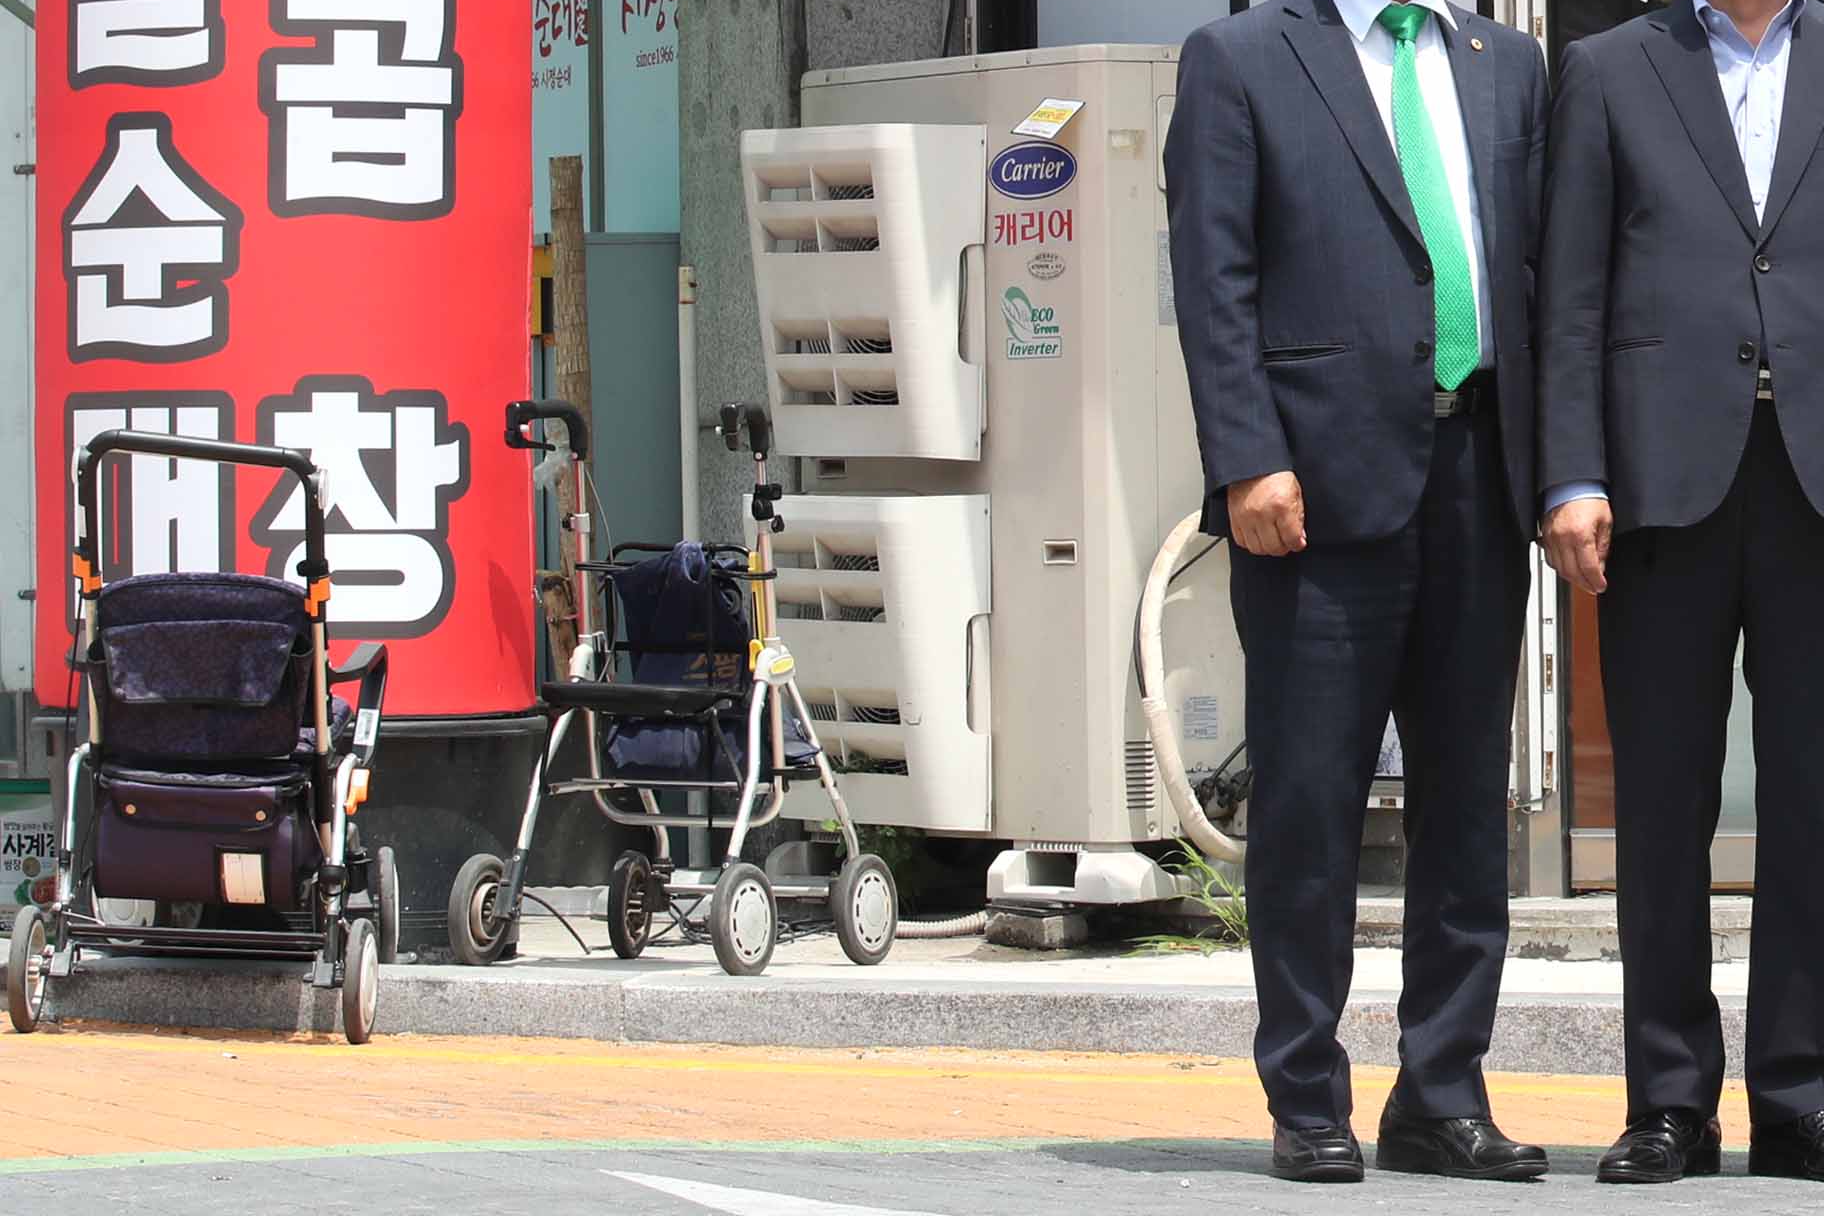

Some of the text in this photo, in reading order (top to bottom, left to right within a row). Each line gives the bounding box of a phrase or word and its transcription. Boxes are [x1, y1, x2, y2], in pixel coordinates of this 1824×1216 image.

[635, 46, 674, 69] since1966
[1002, 156, 1065, 182] Carrier
[994, 209, 1073, 246] 캐리어
[1031, 308, 1054, 323] ECO
[1009, 341, 1059, 356] Inverter
